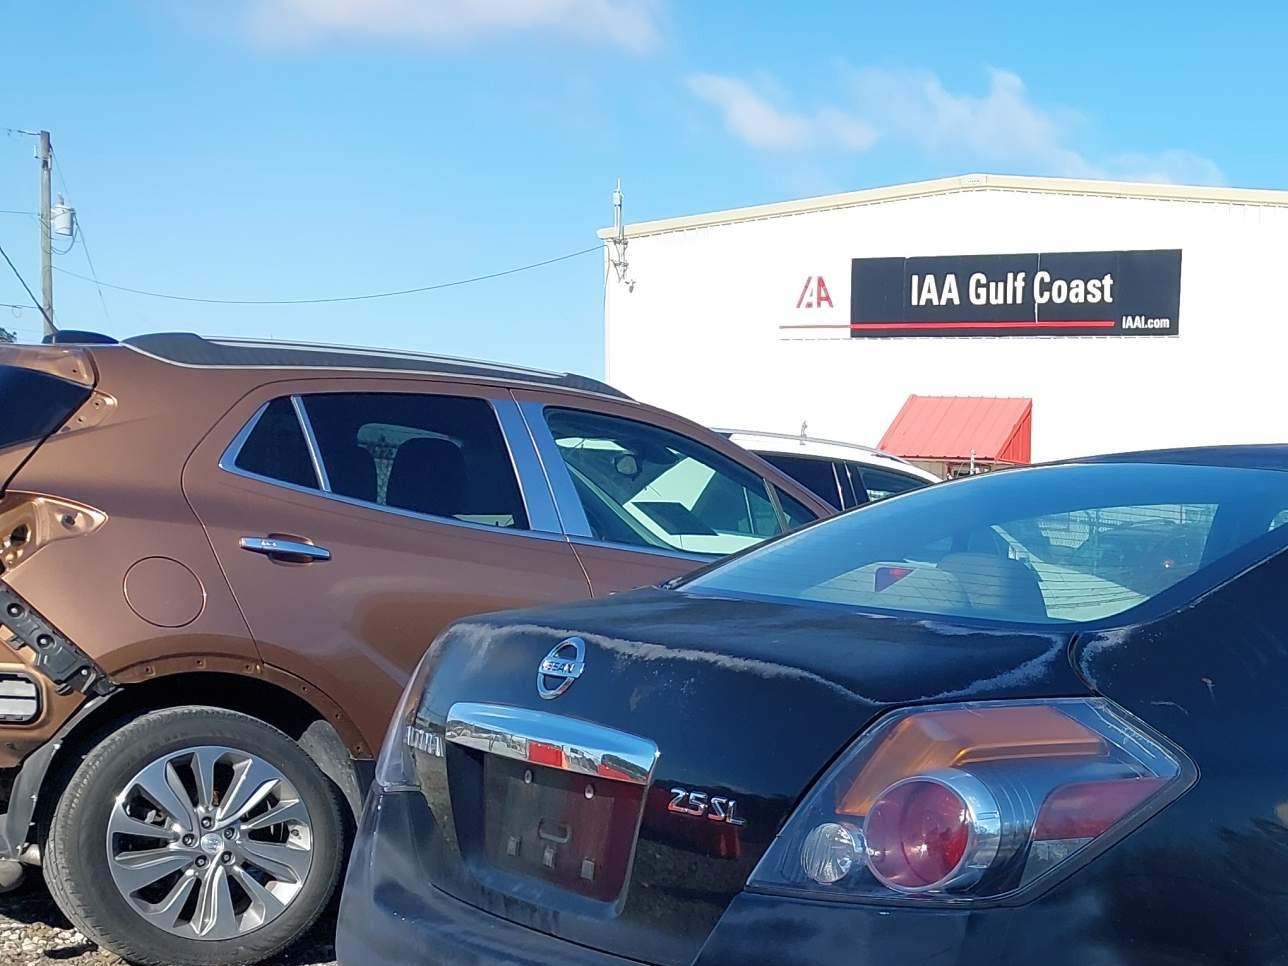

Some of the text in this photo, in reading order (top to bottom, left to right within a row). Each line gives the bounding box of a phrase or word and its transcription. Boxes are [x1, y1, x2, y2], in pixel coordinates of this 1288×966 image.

[911, 271, 1114, 306] IAA Gulf Coast
[1122, 315, 1170, 329] IAAI.com
